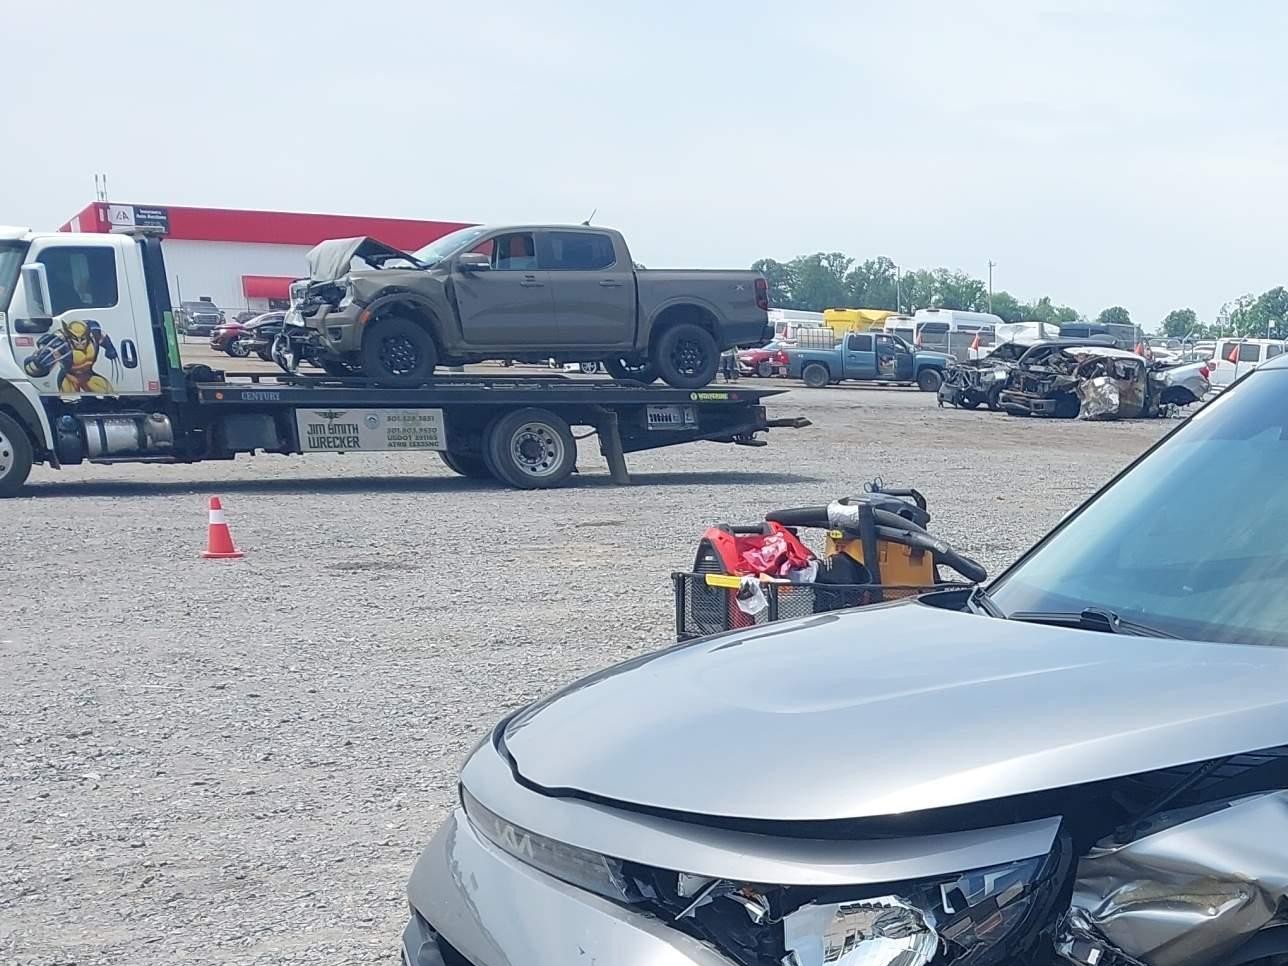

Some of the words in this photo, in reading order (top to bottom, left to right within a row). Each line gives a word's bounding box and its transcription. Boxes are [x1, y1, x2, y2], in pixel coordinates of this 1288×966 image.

[241, 391, 280, 401] CENTURY
[307, 424, 326, 435] JIM
[327, 423, 359, 435] SMITH
[308, 436, 361, 449] WRECKER
